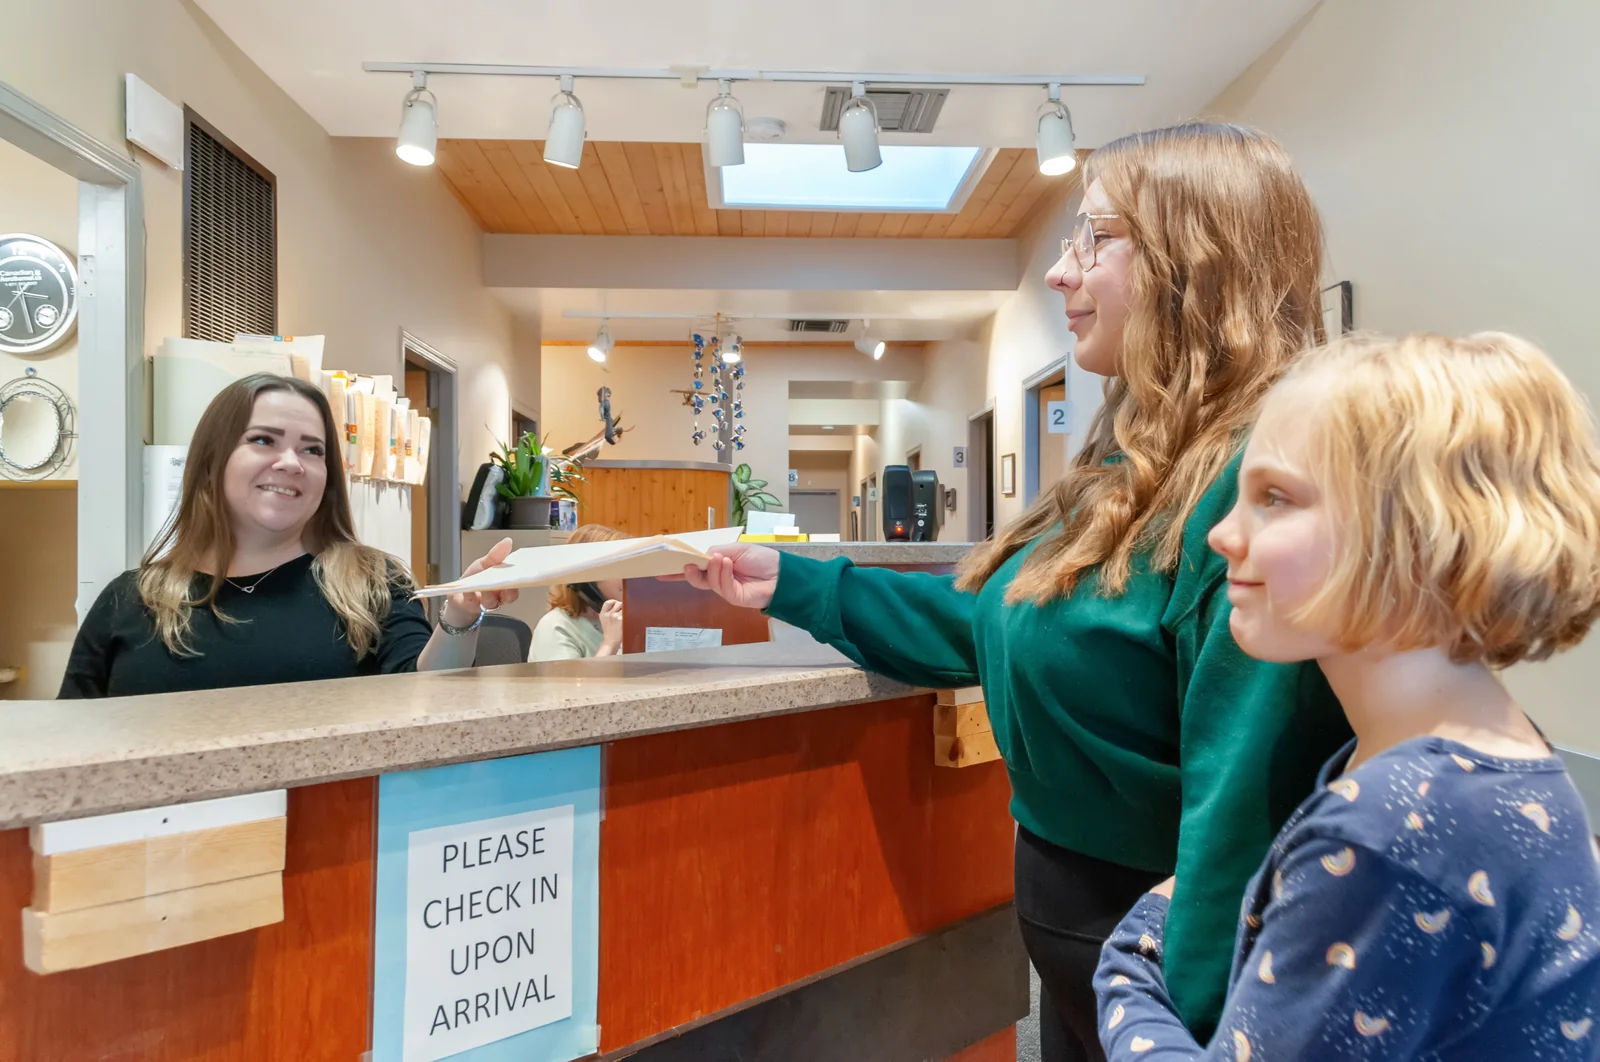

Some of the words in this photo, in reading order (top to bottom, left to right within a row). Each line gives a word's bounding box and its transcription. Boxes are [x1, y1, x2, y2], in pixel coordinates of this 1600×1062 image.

[58, 263, 66, 273] 2
[1052, 408, 1066, 426] 2
[955, 451, 965, 464] 3
[788, 473, 796, 482] 8
[870, 489, 876, 498] 4
[442, 826, 546, 874] PLEASE
[422, 880, 522, 930] CHECK
[531, 872, 559, 905] IN
[449, 927, 536, 976] UPON
[428, 973, 557, 1037] ARRIVAL
